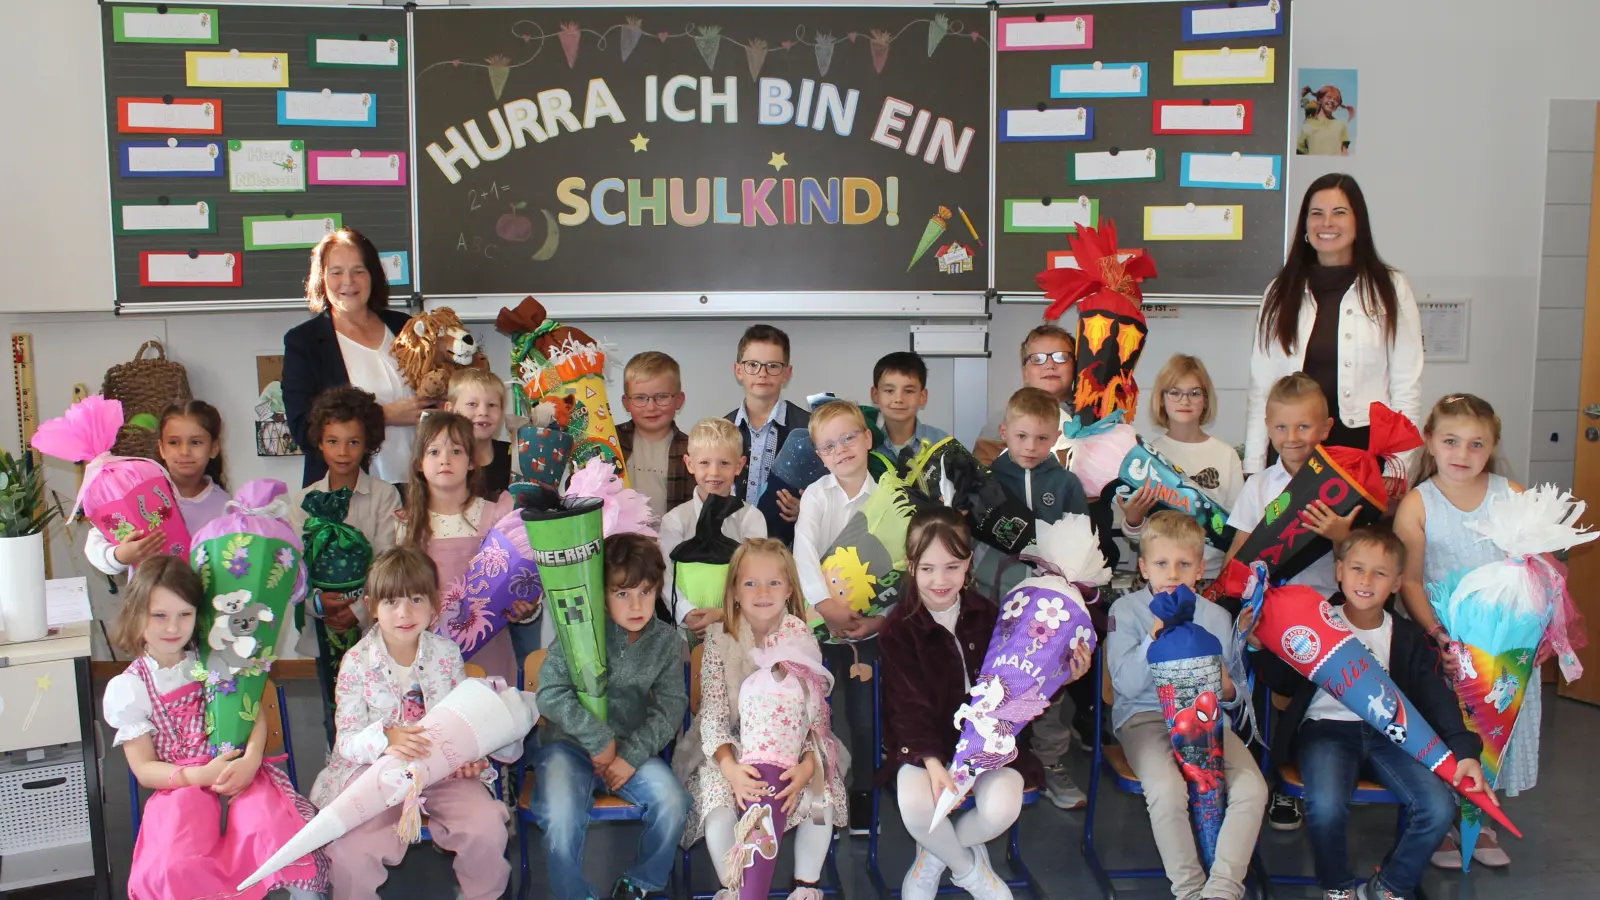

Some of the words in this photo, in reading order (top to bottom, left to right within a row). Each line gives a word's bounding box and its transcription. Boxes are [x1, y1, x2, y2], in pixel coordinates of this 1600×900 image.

[426, 77, 626, 184] HURRA
[645, 74, 738, 124] ICH
[758, 77, 860, 137] BIN
[871, 96, 975, 173] EIN
[246, 146, 287, 162] Herr
[235, 172, 300, 188] Nilsson
[556, 175, 900, 228] SCHULKIND!
[1254, 477, 1349, 566] OKA
[531, 537, 600, 567] INECRAFT
[1286, 629, 1311, 641] BAYERN
